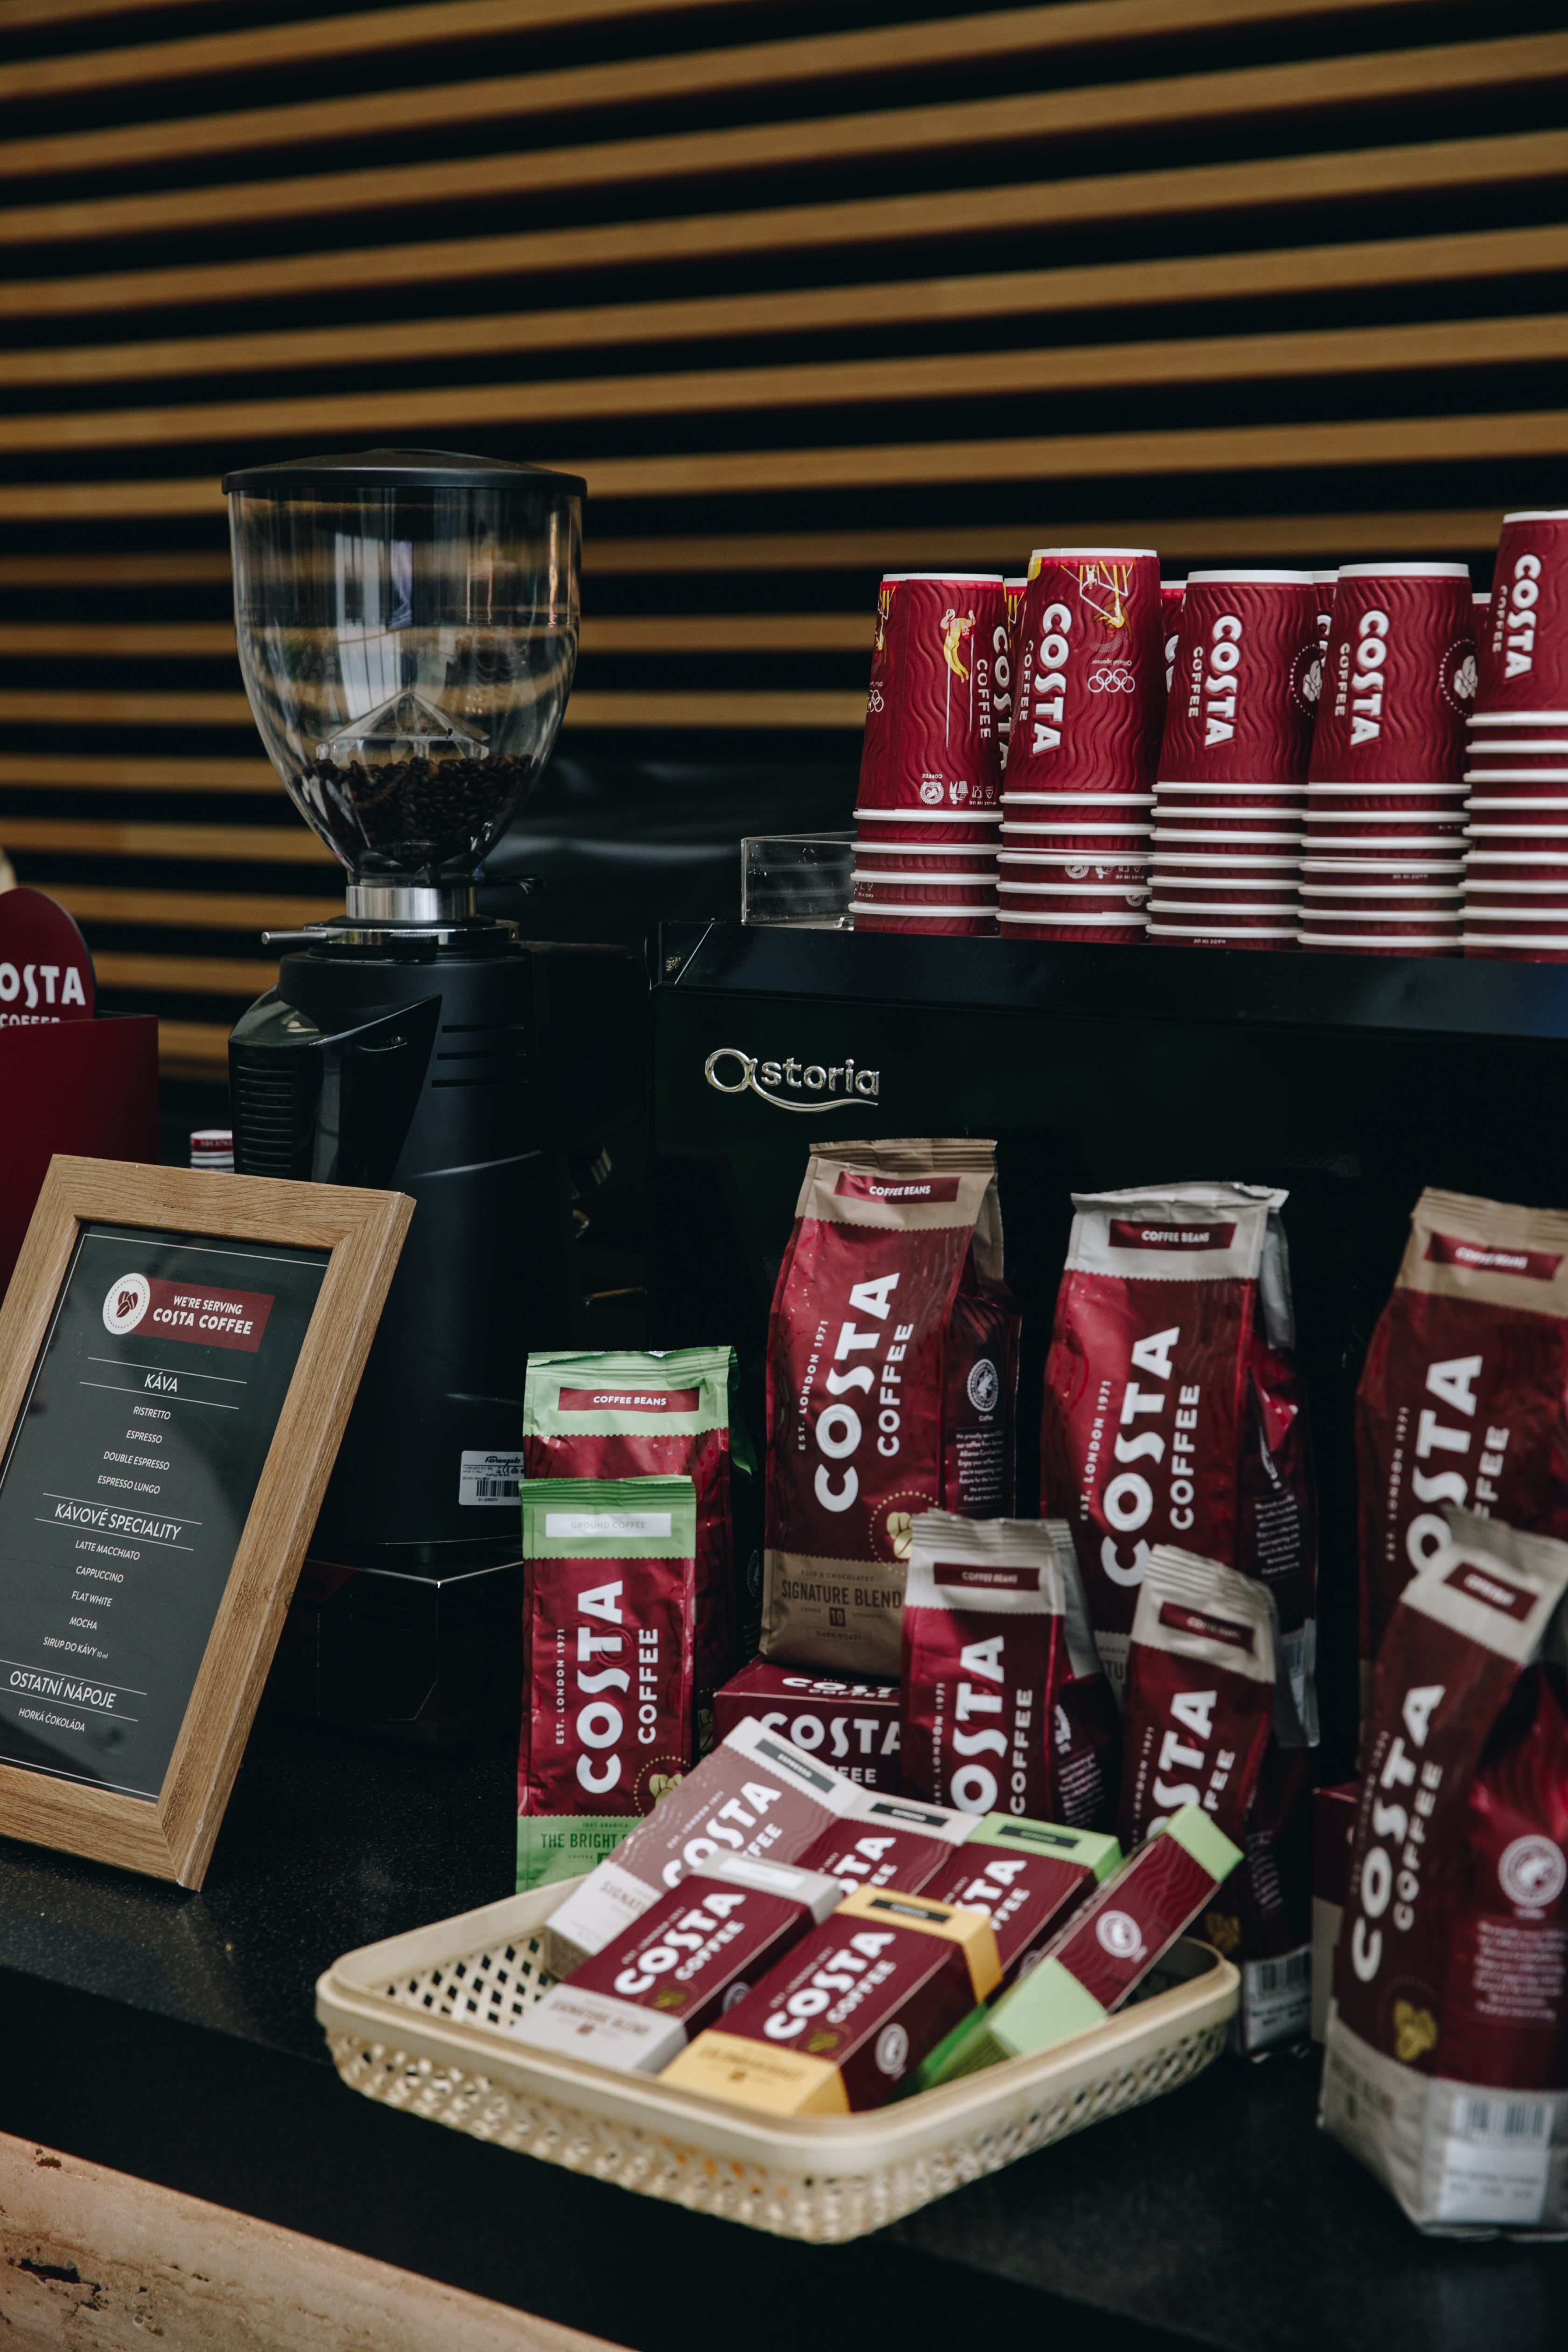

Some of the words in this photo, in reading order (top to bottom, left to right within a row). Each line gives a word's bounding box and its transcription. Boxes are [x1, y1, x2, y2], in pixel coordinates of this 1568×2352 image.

[1493, 585, 1507, 653] COFFEE
[1505, 554, 1541, 679] COSTA
[976, 659, 991, 739] COFFEE
[1020, 640, 1034, 721] COFFEE
[1032, 603, 1072, 755] COSTA
[1188, 646, 1203, 717] COFFEE
[1204, 616, 1243, 746] COSTA
[1335, 643, 1350, 716] COFFEE
[1350, 610, 1389, 746] COSTA
[869, 1185, 903, 1197] COFFEE
[904, 1185, 931, 1196] BEANS
[1141, 1230, 1179, 1243] COFFEE
[1181, 1230, 1210, 1243] BEANS
[153, 1308, 195, 1327] COSTA
[198, 1315, 254, 1335] COFFEE
[173, 1295, 202, 1310] WE'RE
[202, 1299, 243, 1316] SERVING
[144, 1372, 179, 1392] KÁVA
[800, 1353, 818, 1414] LONDON
[814, 1320, 828, 1348] 1971
[815, 1273, 900, 1512] COSTA
[877, 1323, 913, 1456] COFFEE
[1098, 1380, 1112, 1412] 1971
[133, 1406, 171, 1420] RISTRETTO
[593, 1396, 631, 1405] COFFEE
[634, 1396, 666, 1406] BEANS
[103, 1451, 133, 1465] DOUBLE
[133, 1456, 170, 1470] ESPRESSO
[126, 1430, 162, 1444] ESPRESSO
[1084, 1418, 1104, 1484] LONDON
[1101, 1327, 1180, 1586] COSTA
[1170, 1386, 1200, 1530] COFFEE
[97, 1475, 133, 1490] ESPRESSO
[133, 1482, 161, 1494] LUNGO
[1080, 1491, 1091, 1520] EST.
[55, 1502, 109, 1527] KÁVOVÉ
[108, 1513, 182, 1540] SPECIALITY
[75, 1540, 96, 1553] LATTE
[96, 1543, 140, 1561] MACCHIATO
[71, 1591, 89, 1602] FLAT
[89, 1594, 113, 1607] WHITE
[76, 1566, 124, 1583] CAPPUCCINO
[781, 1580, 849, 1605] SIGNATURE
[854, 1589, 902, 1608] BLEND
[43, 1637, 65, 1650] SIRUP
[64, 1641, 77, 1652] DO
[77, 1642, 98, 1656] KÁVY
[69, 1617, 98, 1630] MOCHA
[557, 1629, 565, 1655] 1971
[9, 1670, 65, 1696] OSTATNÍ
[63, 1681, 117, 1709] NÁPOJE
[556, 1659, 565, 1715] LONDON
[576, 1580, 630, 1794] COSTA
[638, 1629, 658, 1744] COFFEE
[18, 1708, 45, 1722] HORKÁ
[44, 1714, 85, 1732] ČOKOLÁDA
[556, 1719, 564, 1744] EST.
[932, 1715, 944, 1774] LONDON
[950, 1636, 1008, 1815] OSTA
[1010, 1689, 1033, 1815] COFFEE
[540, 1833, 565, 1848] THE
[570, 1834, 618, 1848] BRIGHT
[663, 1782, 783, 1890] COSTA
[1351, 1684, 1445, 1982] COSTA
[1394, 1760, 1442, 1931] COFFEE
[614, 1893, 747, 1995] COSTA
[674, 1920, 745, 1981] COFFEE
[763, 1932, 896, 2040] COSTA
[826, 1960, 896, 2024] COFFEE
